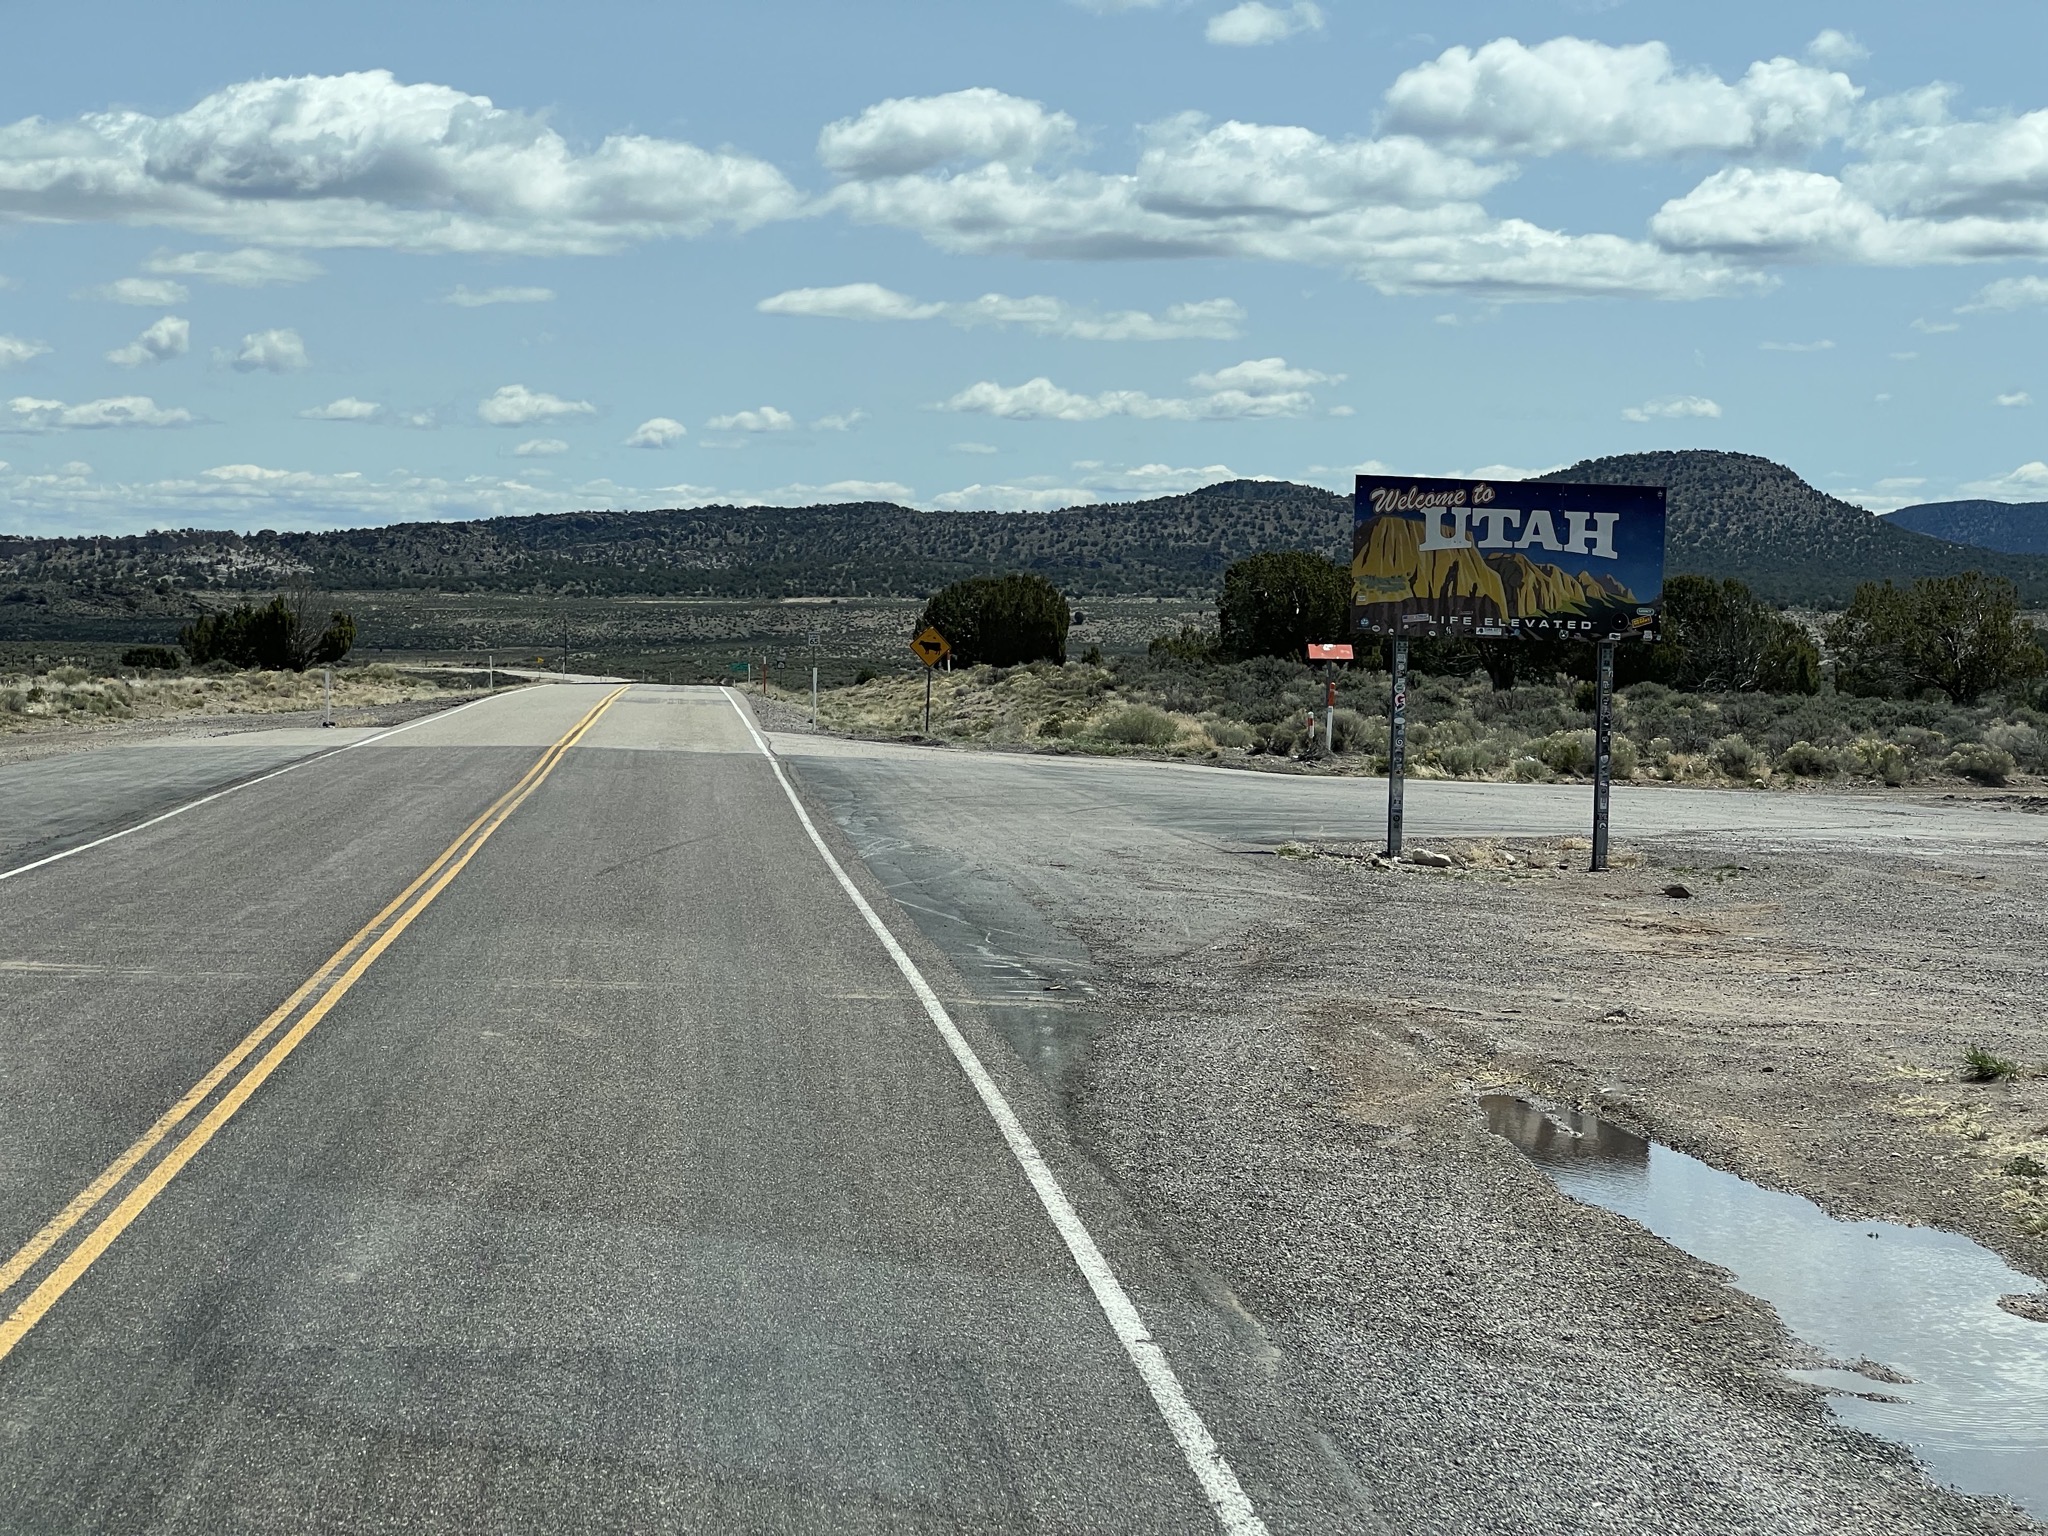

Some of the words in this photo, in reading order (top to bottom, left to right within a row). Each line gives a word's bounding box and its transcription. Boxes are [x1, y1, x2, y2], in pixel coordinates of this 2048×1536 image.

[1371, 486, 1466, 513] Welcome
[1473, 483, 1495, 503] to
[1419, 506, 1620, 559] UTAH
[1428, 615, 1472, 625] LIFE
[1484, 617, 1592, 630] ELEVATED
